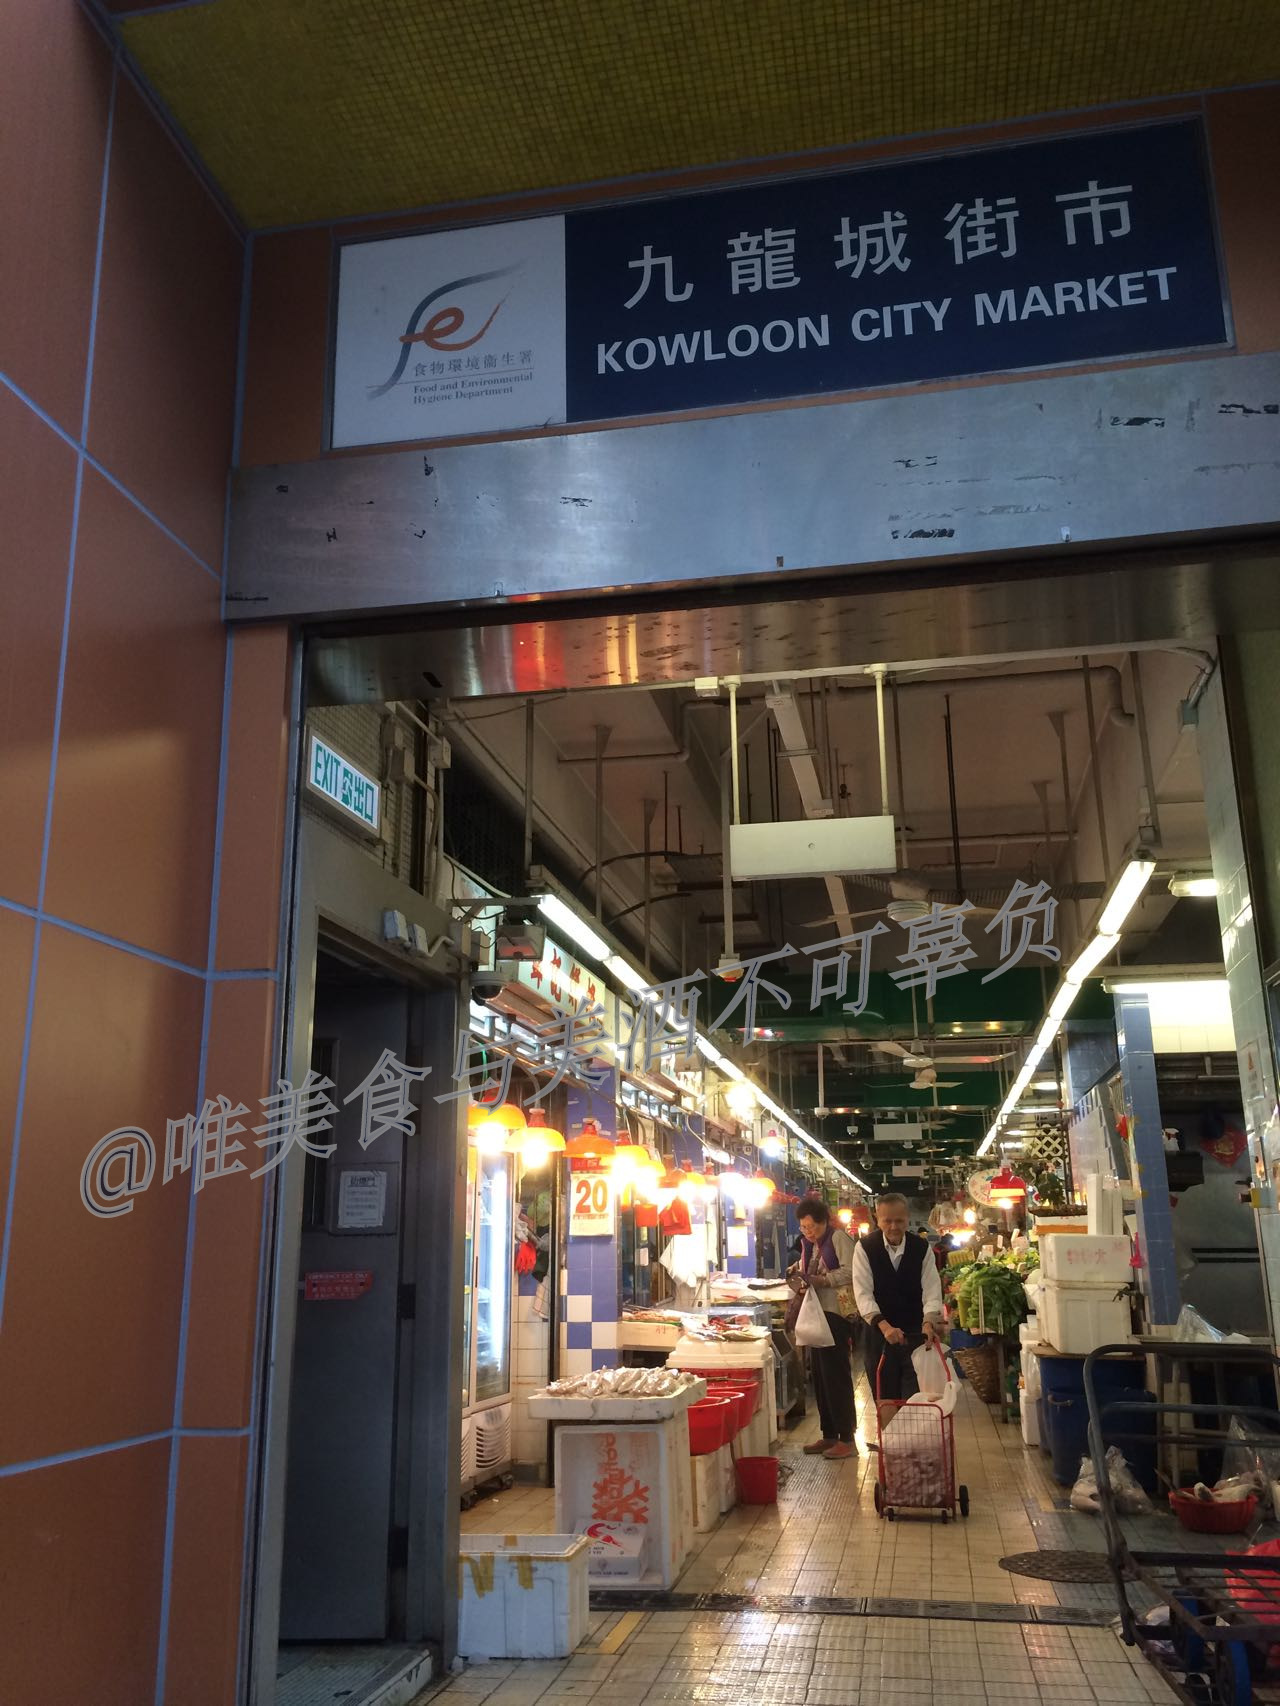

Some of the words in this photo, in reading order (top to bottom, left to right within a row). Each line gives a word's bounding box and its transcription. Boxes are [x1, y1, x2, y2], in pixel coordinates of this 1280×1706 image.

[623, 180, 1133, 310] 九龍城街市
[597, 314, 830, 375] KOWLOON
[851, 297, 952, 343] CITY
[974, 266, 1178, 327] MARKET
[413, 384, 438, 395] Food
[440, 381, 458, 391] and
[461, 371, 534, 388] Environmental
[413, 392, 453, 405] Hygiene
[455, 385, 514, 401] Department
[314, 743, 341, 797] EXIT
[354, 775, 375, 824] 出口
[575, 1179, 608, 1214] 20
